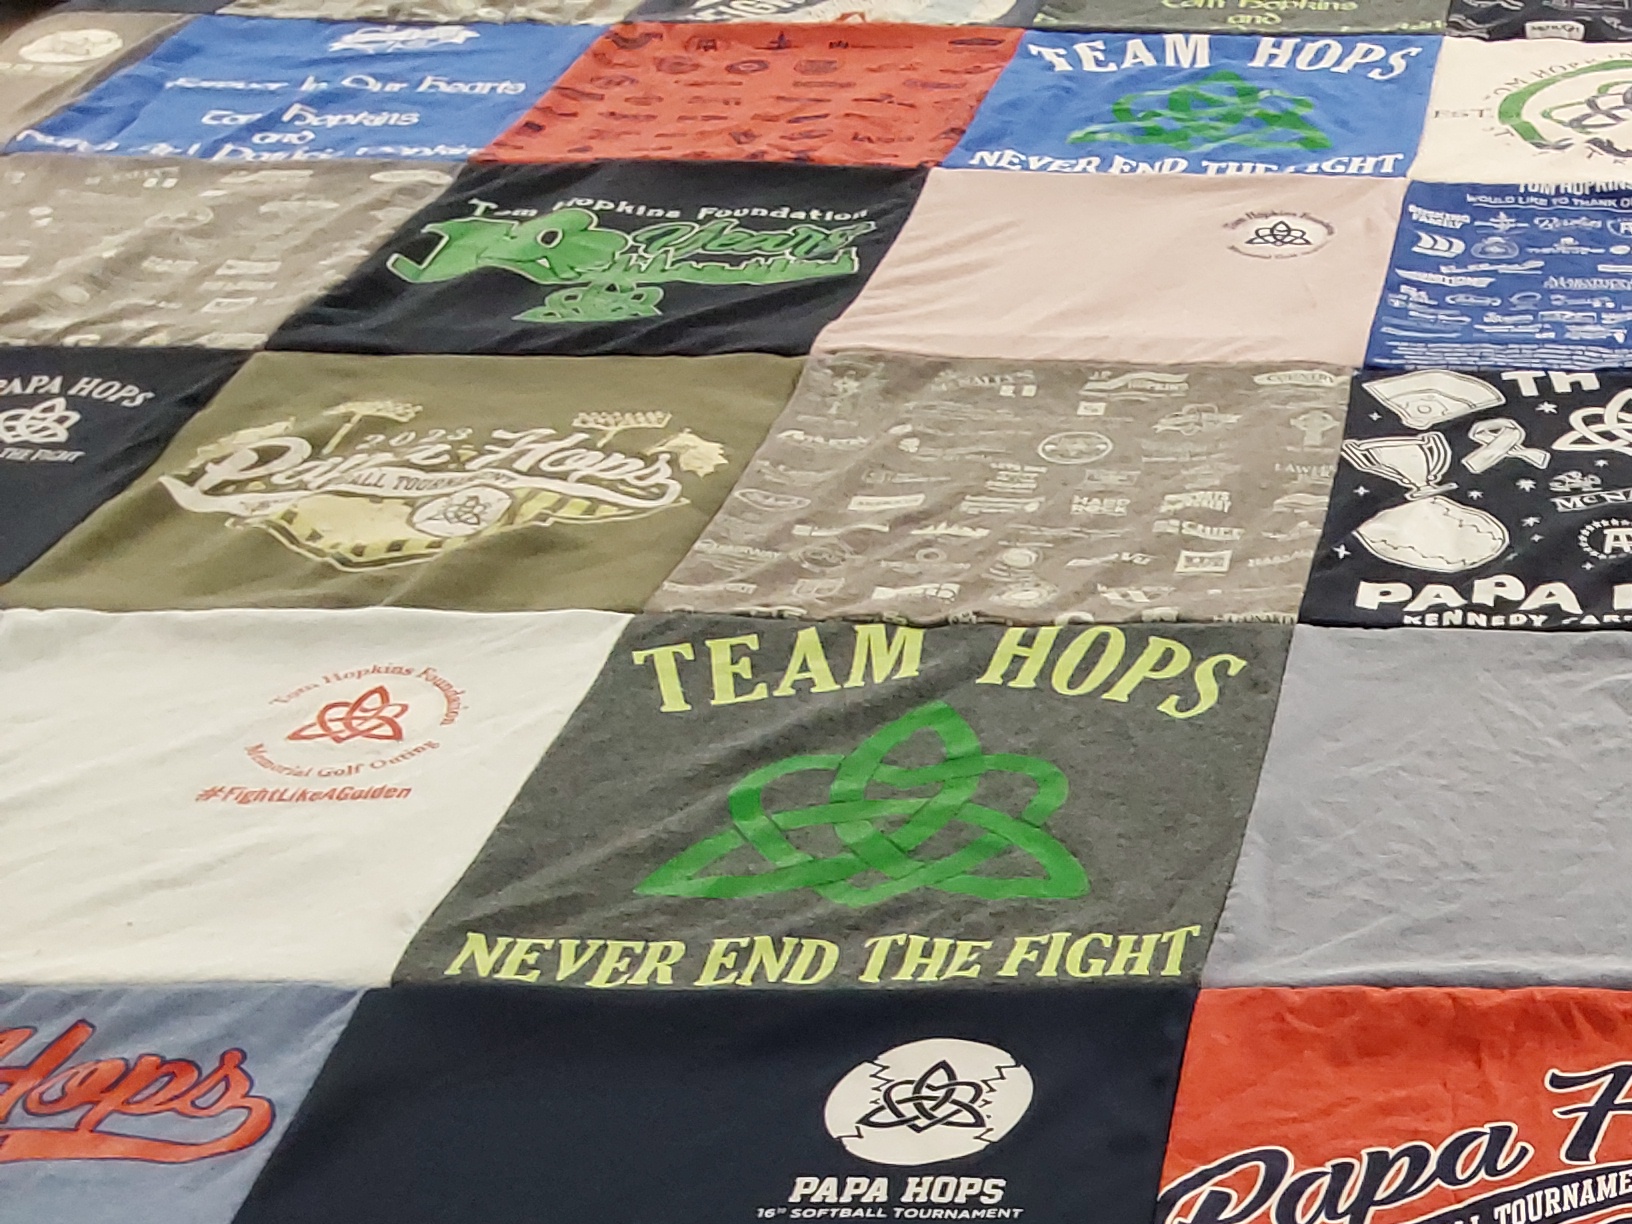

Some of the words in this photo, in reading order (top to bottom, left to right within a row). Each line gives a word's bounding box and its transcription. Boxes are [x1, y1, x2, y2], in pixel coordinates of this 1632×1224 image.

[1027, 33, 1211, 73] TEAM
[1247, 37, 1423, 81] HOPS
[967, 149, 1101, 173] NEVER
[697, 203, 869, 222] Foundation
[67, 376, 156, 408] HOPS
[1353, 573, 1584, 615] PAPA
[1402, 609, 1549, 628] KENNEDY
[632, 624, 926, 713] TEAM
[976, 624, 1248, 721] HOPS
[321, 663, 416, 688] Hopkins
[416, 665, 472, 727] Foundation
[244, 742, 313, 779] Memorial
[316, 763, 364, 779] Golf
[368, 738, 442, 771] Outing
[444, 931, 686, 989] NEVER
[692, 934, 843, 988] END
[861, 934, 992, 985] THE
[997, 924, 1203, 982] FIGHT
[787, 1176, 890, 1204] PAPA
[899, 1176, 1008, 1205] HOPS
[789, 1207, 888, 1219] SOFTBALL
[892, 1207, 1024, 1220] TOURNAMENT
